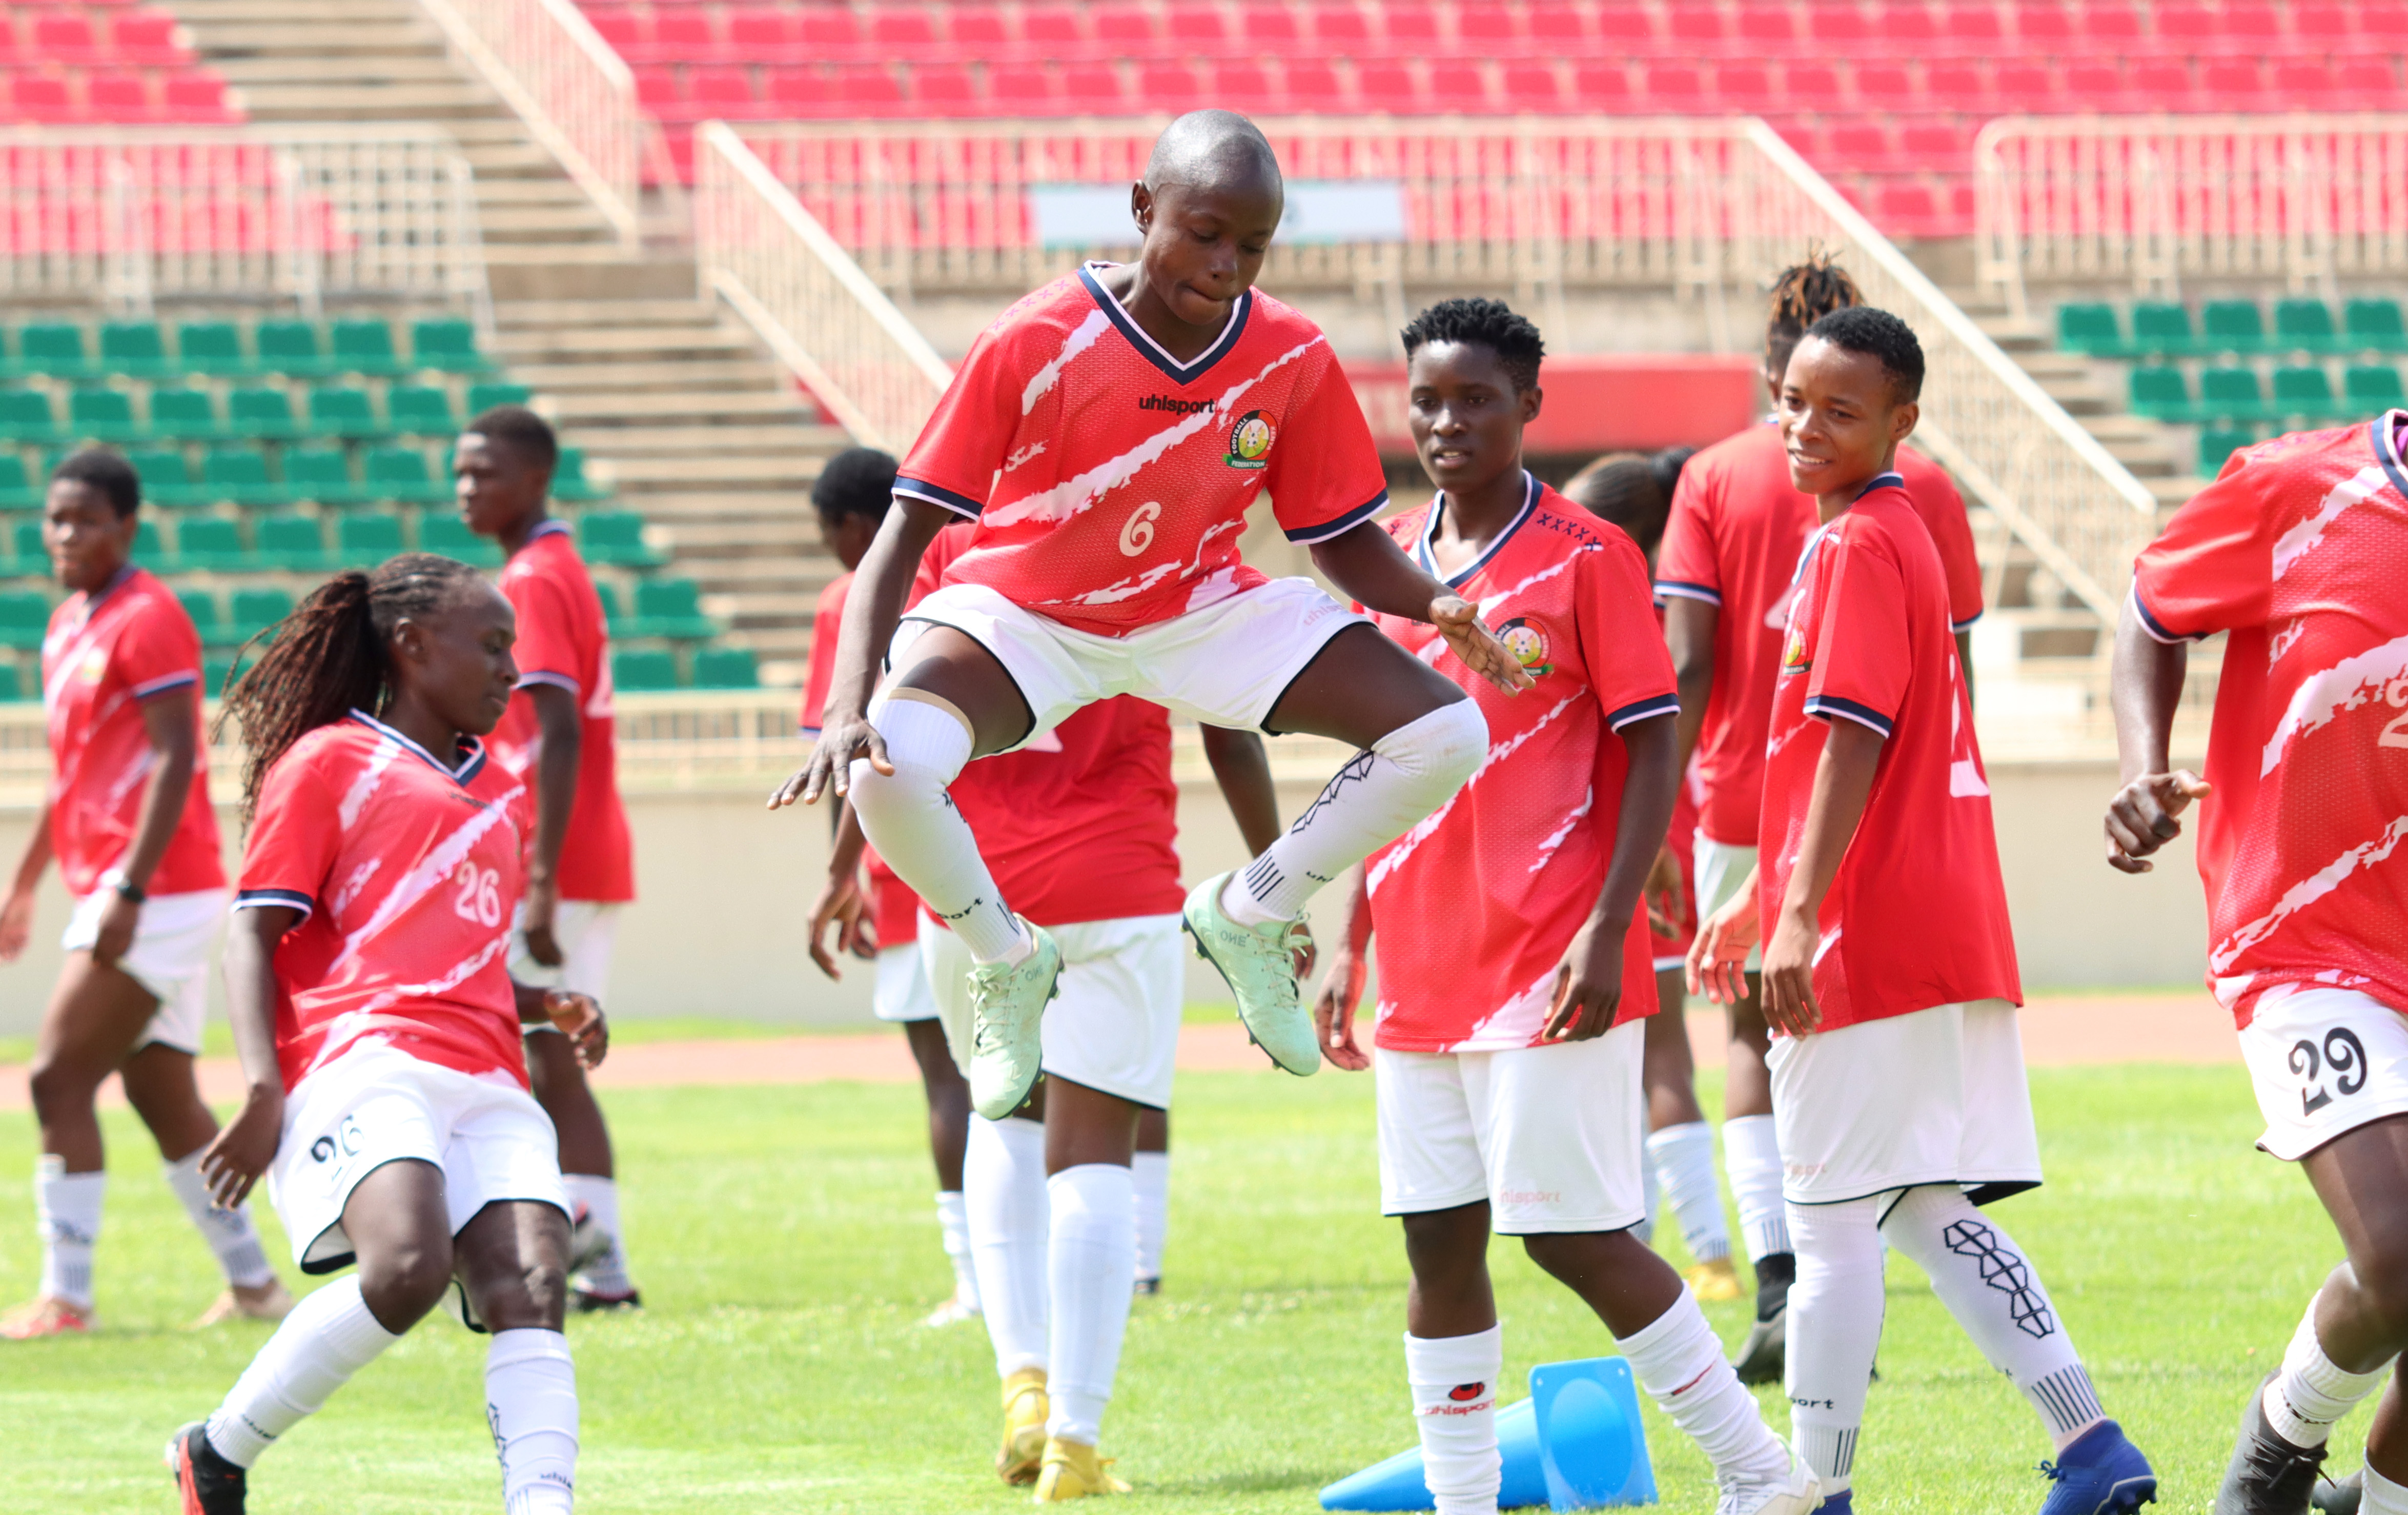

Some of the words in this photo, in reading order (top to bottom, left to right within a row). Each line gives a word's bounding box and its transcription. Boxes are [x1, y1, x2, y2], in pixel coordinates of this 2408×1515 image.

[1139, 394, 1214, 416] uhlsport
[1231, 418, 1249, 455] FOOTBALL
[1119, 501, 1161, 557] 6
[454, 861, 502, 927] 26
[2289, 1027, 2367, 1117] 29
[311, 1114, 365, 1183] 26
